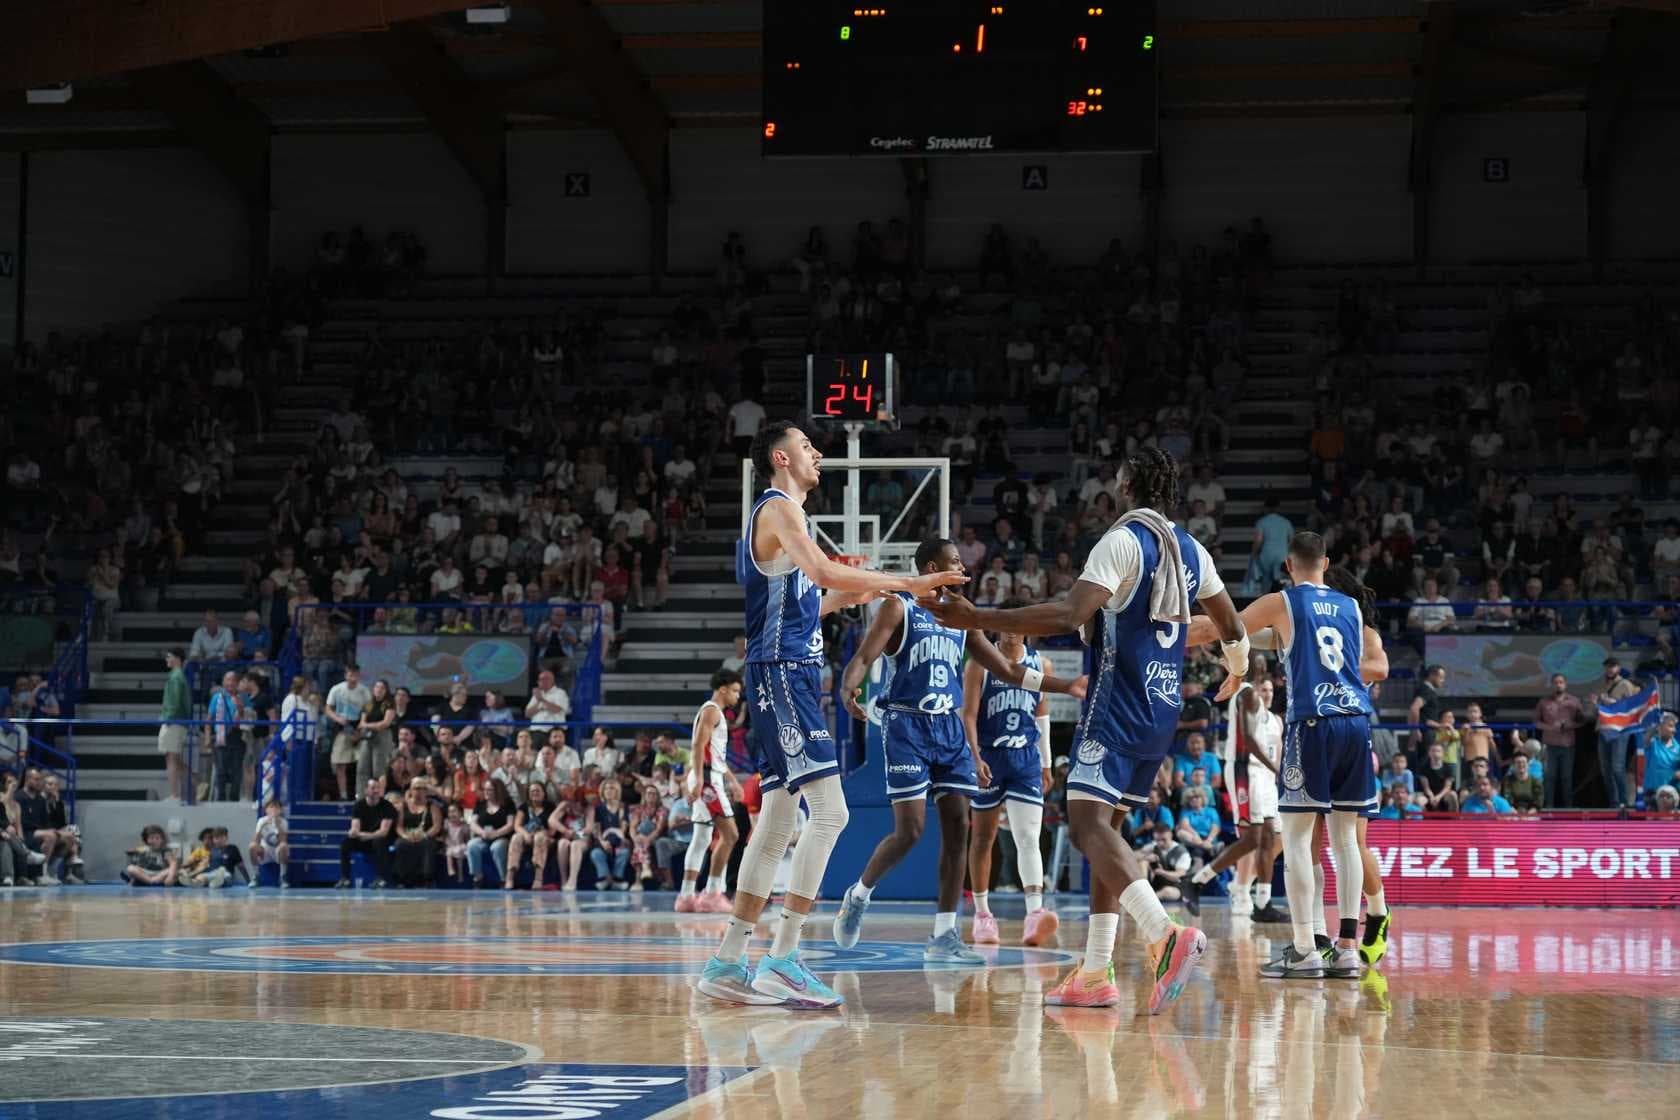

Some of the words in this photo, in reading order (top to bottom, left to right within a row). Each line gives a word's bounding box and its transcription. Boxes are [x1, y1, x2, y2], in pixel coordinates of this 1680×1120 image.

[840, 26, 850, 40] 8
[1143, 35, 1154, 49] 2
[1067, 102, 1086, 116] 32
[765, 123, 776, 137] 2
[925, 135, 995, 150] STRAMATEL
[1025, 167, 1044, 188] A
[1488, 159, 1505, 180] B
[568, 175, 585, 195] X
[825, 384, 872, 416] 24
[1312, 601, 1340, 618] DIOT
[1316, 626, 1345, 674] 8
[928, 663, 949, 689] 19
[1006, 711, 1021, 732] 9
[1326, 847, 1453, 878] VEZ
[1468, 848, 1520, 878] LE
[1532, 847, 1680, 880] SPORT
